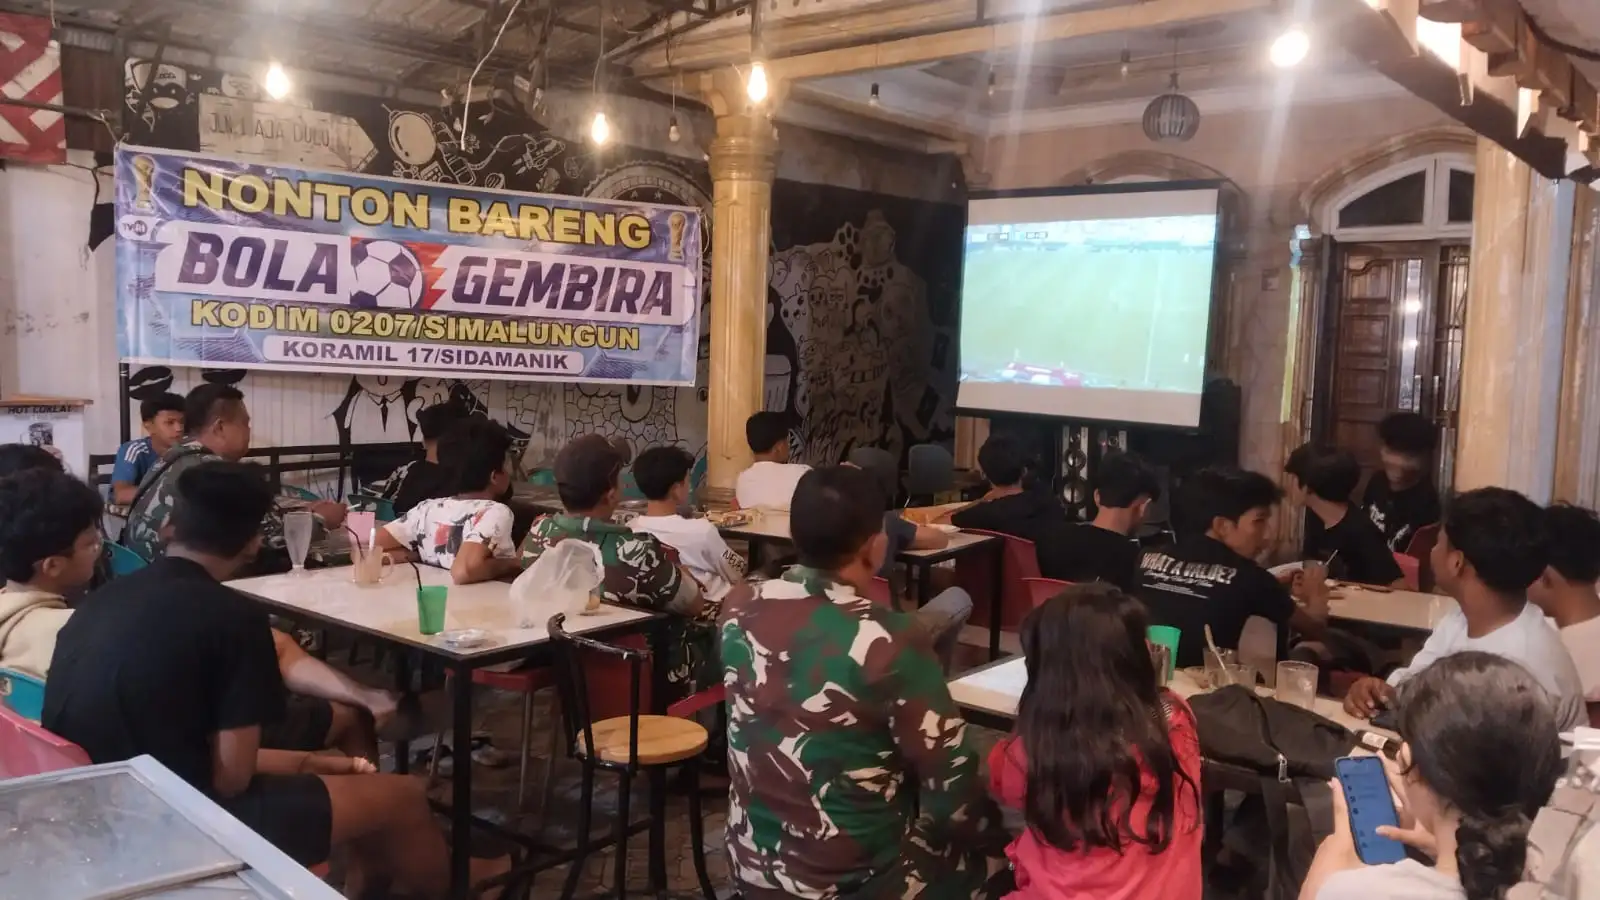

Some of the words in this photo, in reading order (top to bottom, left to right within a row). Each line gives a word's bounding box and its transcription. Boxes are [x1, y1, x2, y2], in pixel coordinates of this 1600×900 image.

[183, 167, 430, 231] NONTON
[447, 197, 651, 250] BARENG
[177, 231, 338, 295] BOLA
[451, 255, 673, 317] GEMBIRA
[191, 299, 319, 333] KODIM
[329, 309, 640, 350] 0207/SIMALUNGUN
[283, 340, 398, 361] KORAMIL
[407, 347, 568, 370] 17/SIDAMANIK
[1140, 552, 1176, 572] WHAT
[1170, 561, 1184, 575] A
